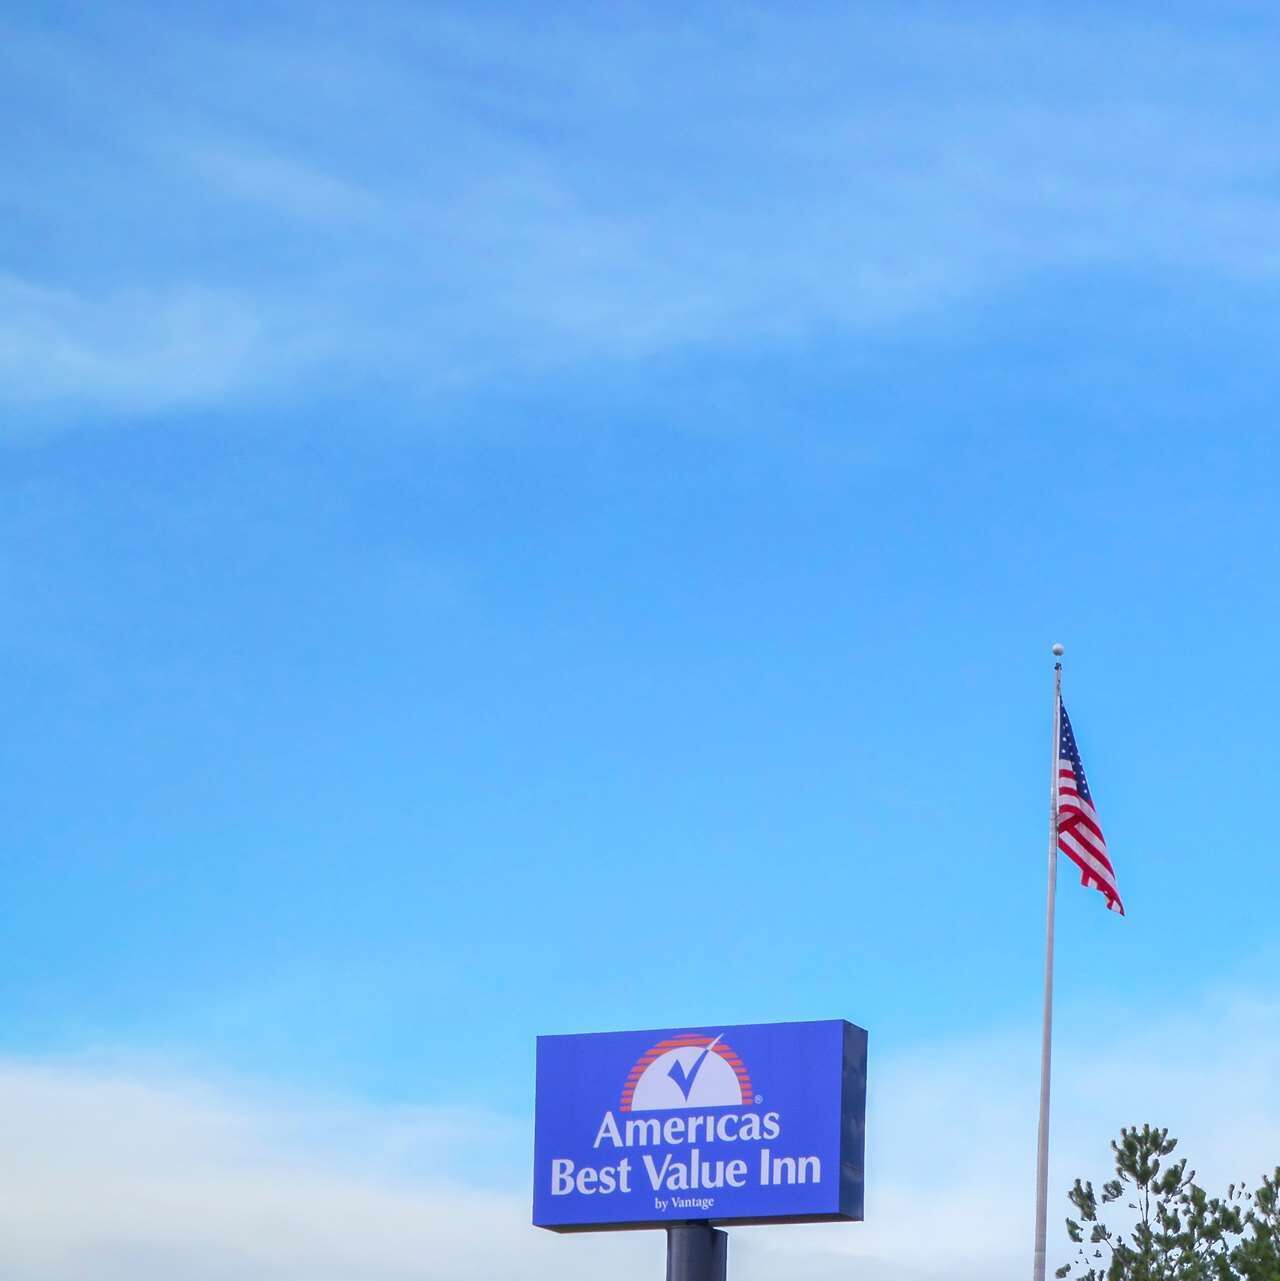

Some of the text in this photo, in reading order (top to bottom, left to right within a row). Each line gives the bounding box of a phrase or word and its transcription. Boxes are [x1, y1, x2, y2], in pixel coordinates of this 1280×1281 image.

[593, 1111, 780, 1148] Americas
[551, 1148, 821, 1195] Best Value Inn
[655, 1196, 715, 1212] by Vantage
